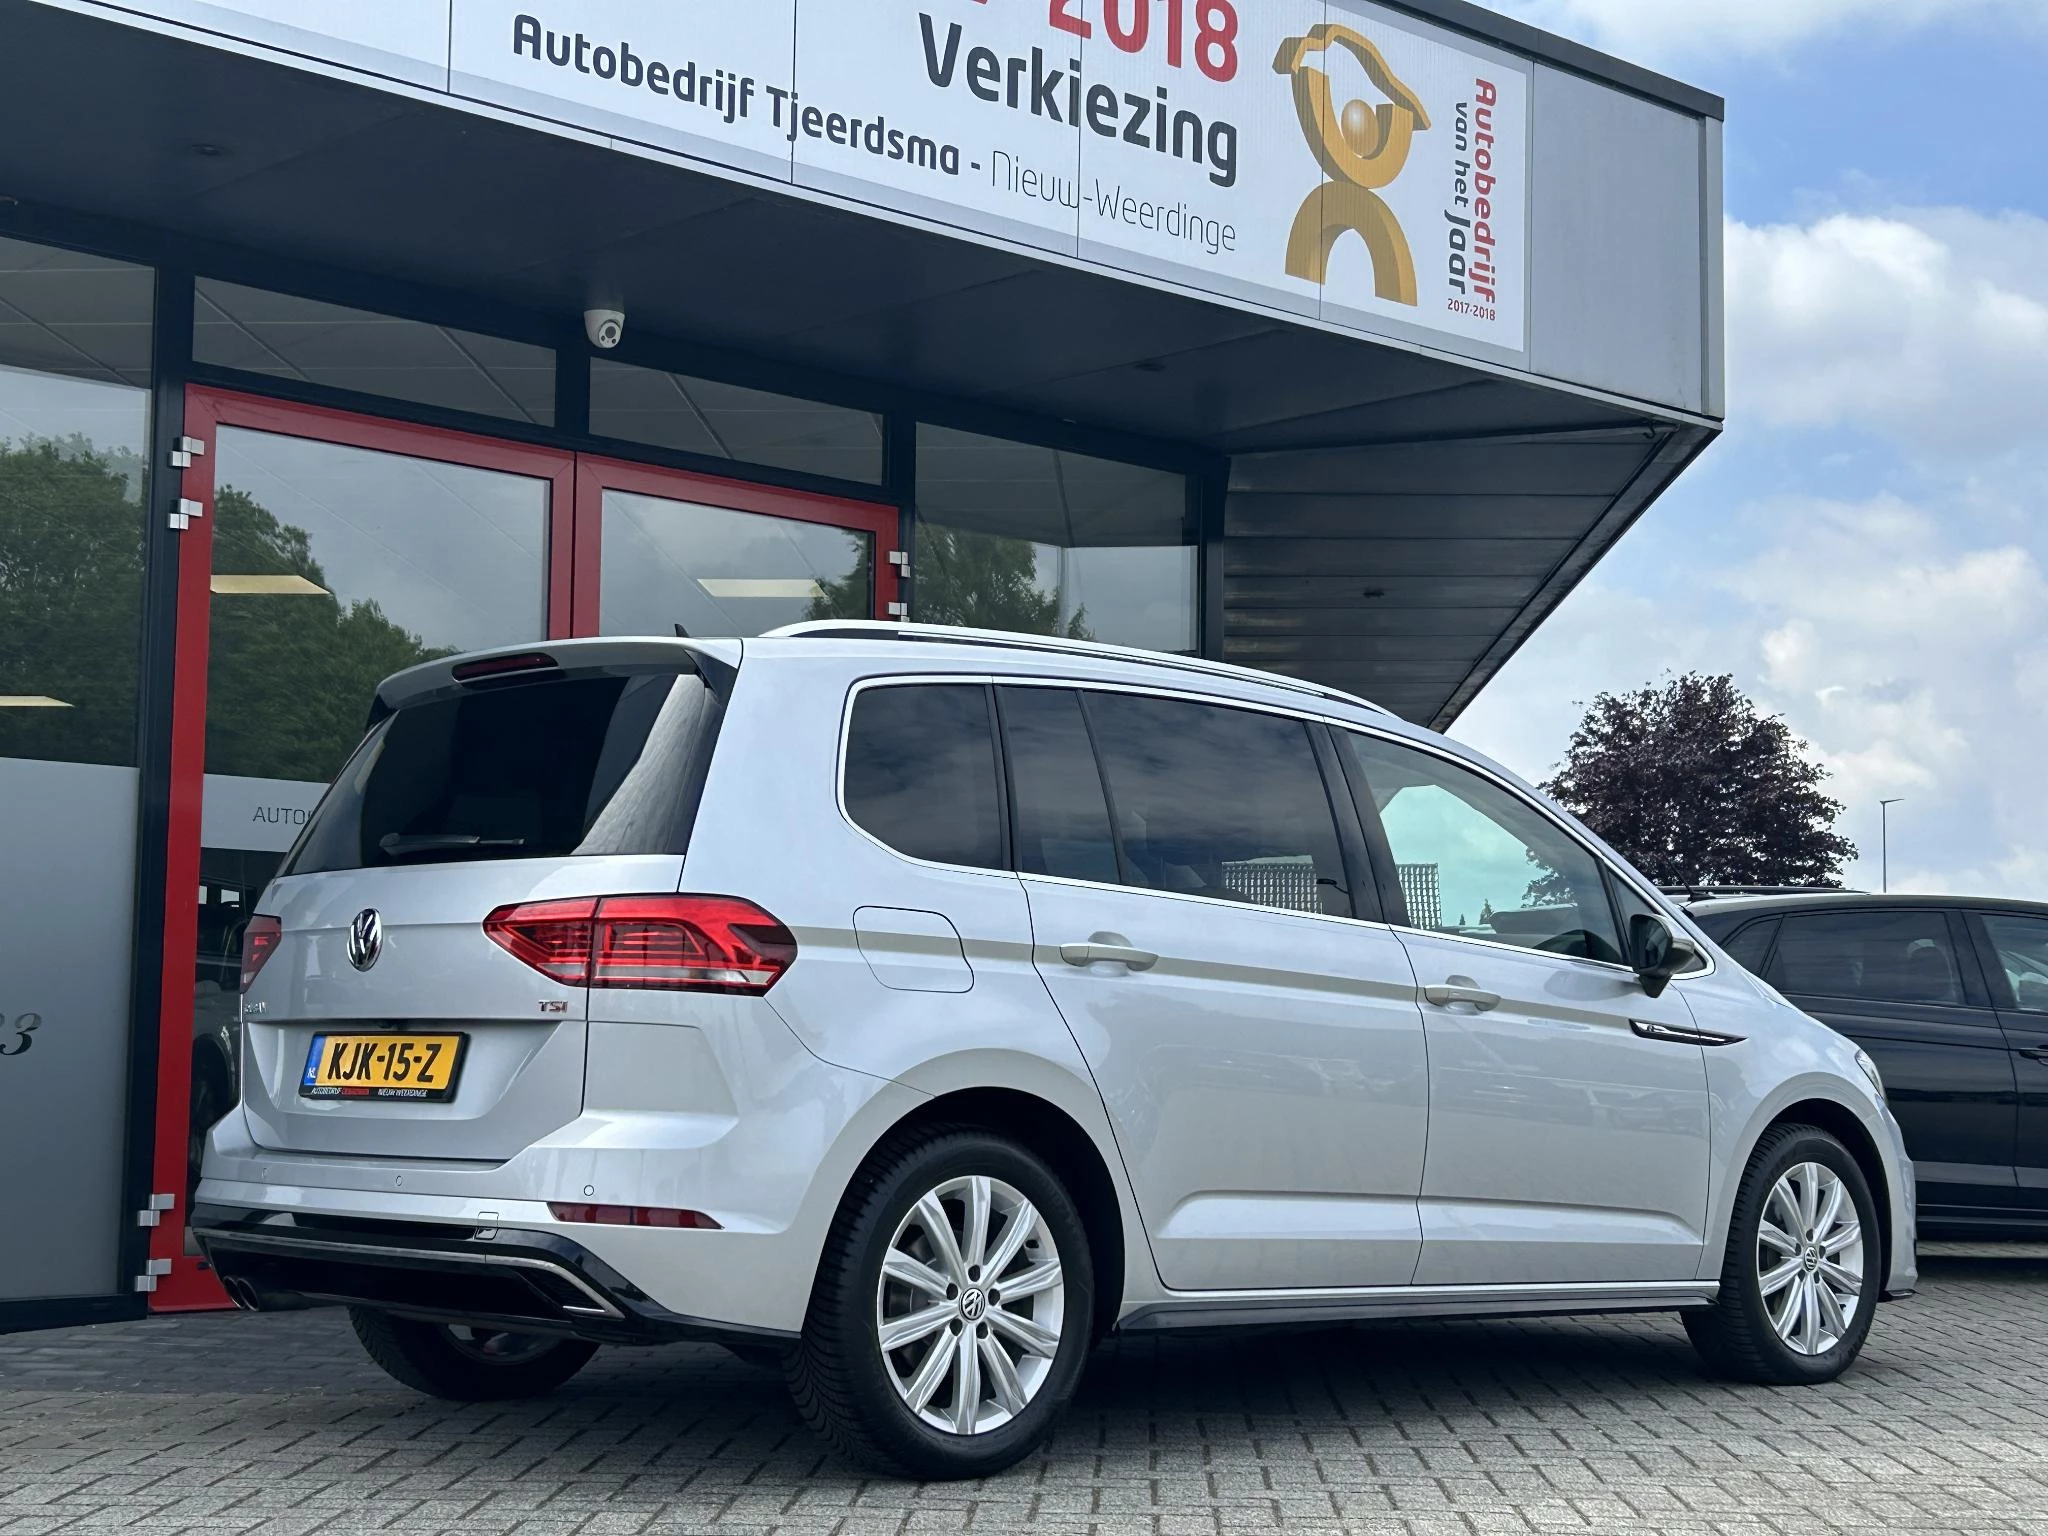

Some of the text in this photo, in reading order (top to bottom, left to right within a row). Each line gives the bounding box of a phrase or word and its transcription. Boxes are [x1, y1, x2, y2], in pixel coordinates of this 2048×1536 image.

[918, 12, 1238, 188] Verkiezing
[513, 13, 755, 124] Autobedrijf
[765, 85, 959, 176] Tjeerdsma
[992, 150, 1236, 255] Nieuw-Weerdinge
[1455, 102, 1468, 152] van
[1454, 159, 1471, 208] het
[1468, 78, 1497, 304] Autobedrijf
[538, 1000, 568, 1014] TSI
[0, 1012, 42, 1056] 3
[327, 1042, 442, 1083] KJK-15-Z
